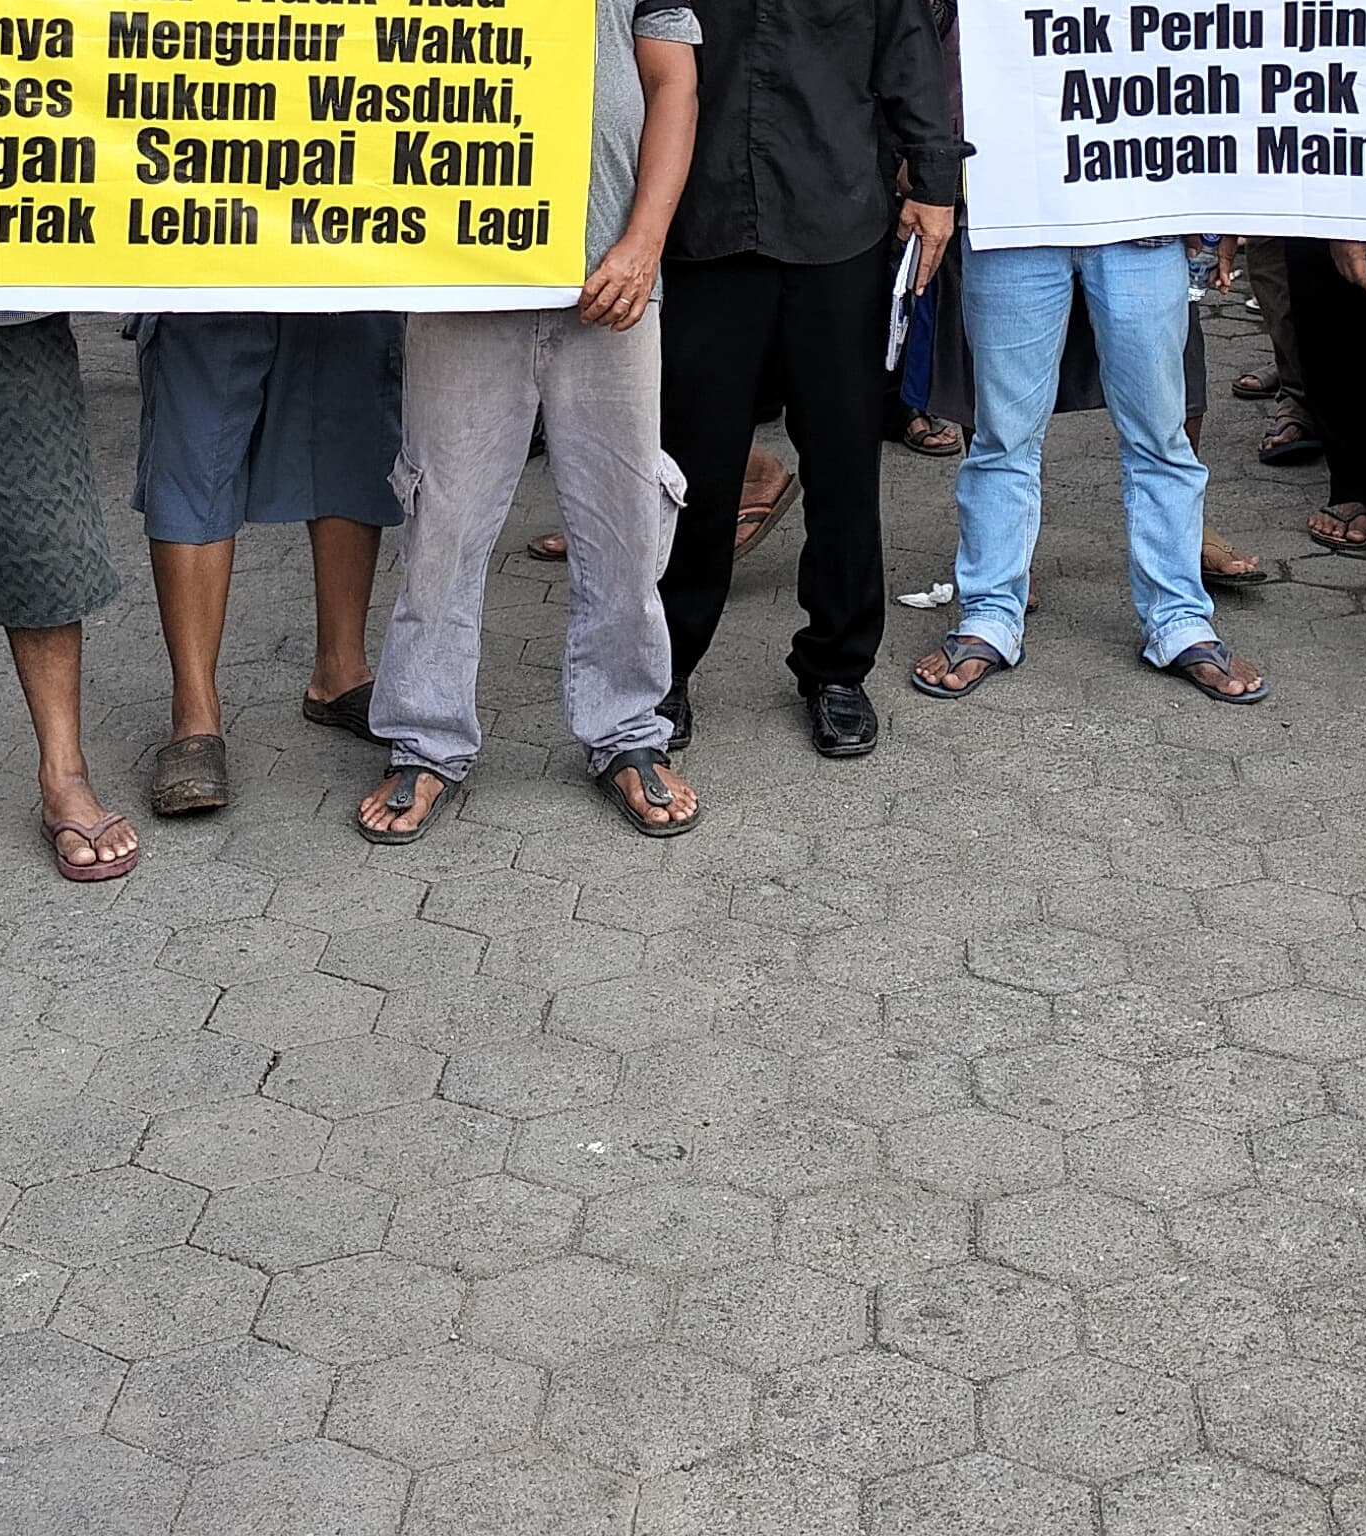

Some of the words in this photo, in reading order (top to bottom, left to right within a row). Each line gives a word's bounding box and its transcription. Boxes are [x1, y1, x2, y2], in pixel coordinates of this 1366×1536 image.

[108, 11, 345, 67] Mengulur
[375, 16, 532, 70] Waktu,
[1024, 6, 1113, 57] Tak
[1130, 3, 1263, 52] Perlu
[1283, 0, 1366, 53] Ijin
[106, 73, 277, 121] Hukum
[308, 75, 522, 129] Wasduki,
[1060, 65, 1240, 125] Ayolah
[1261, 62, 1360, 115] Pak
[136, 126, 356, 191] Sampai
[392, 130, 534, 187] Kami
[1063, 134, 1237, 184] Jangan
[128, 198, 258, 246] Lebih
[290, 198, 426, 245] Keras
[457, 199, 550, 252] Lagi
